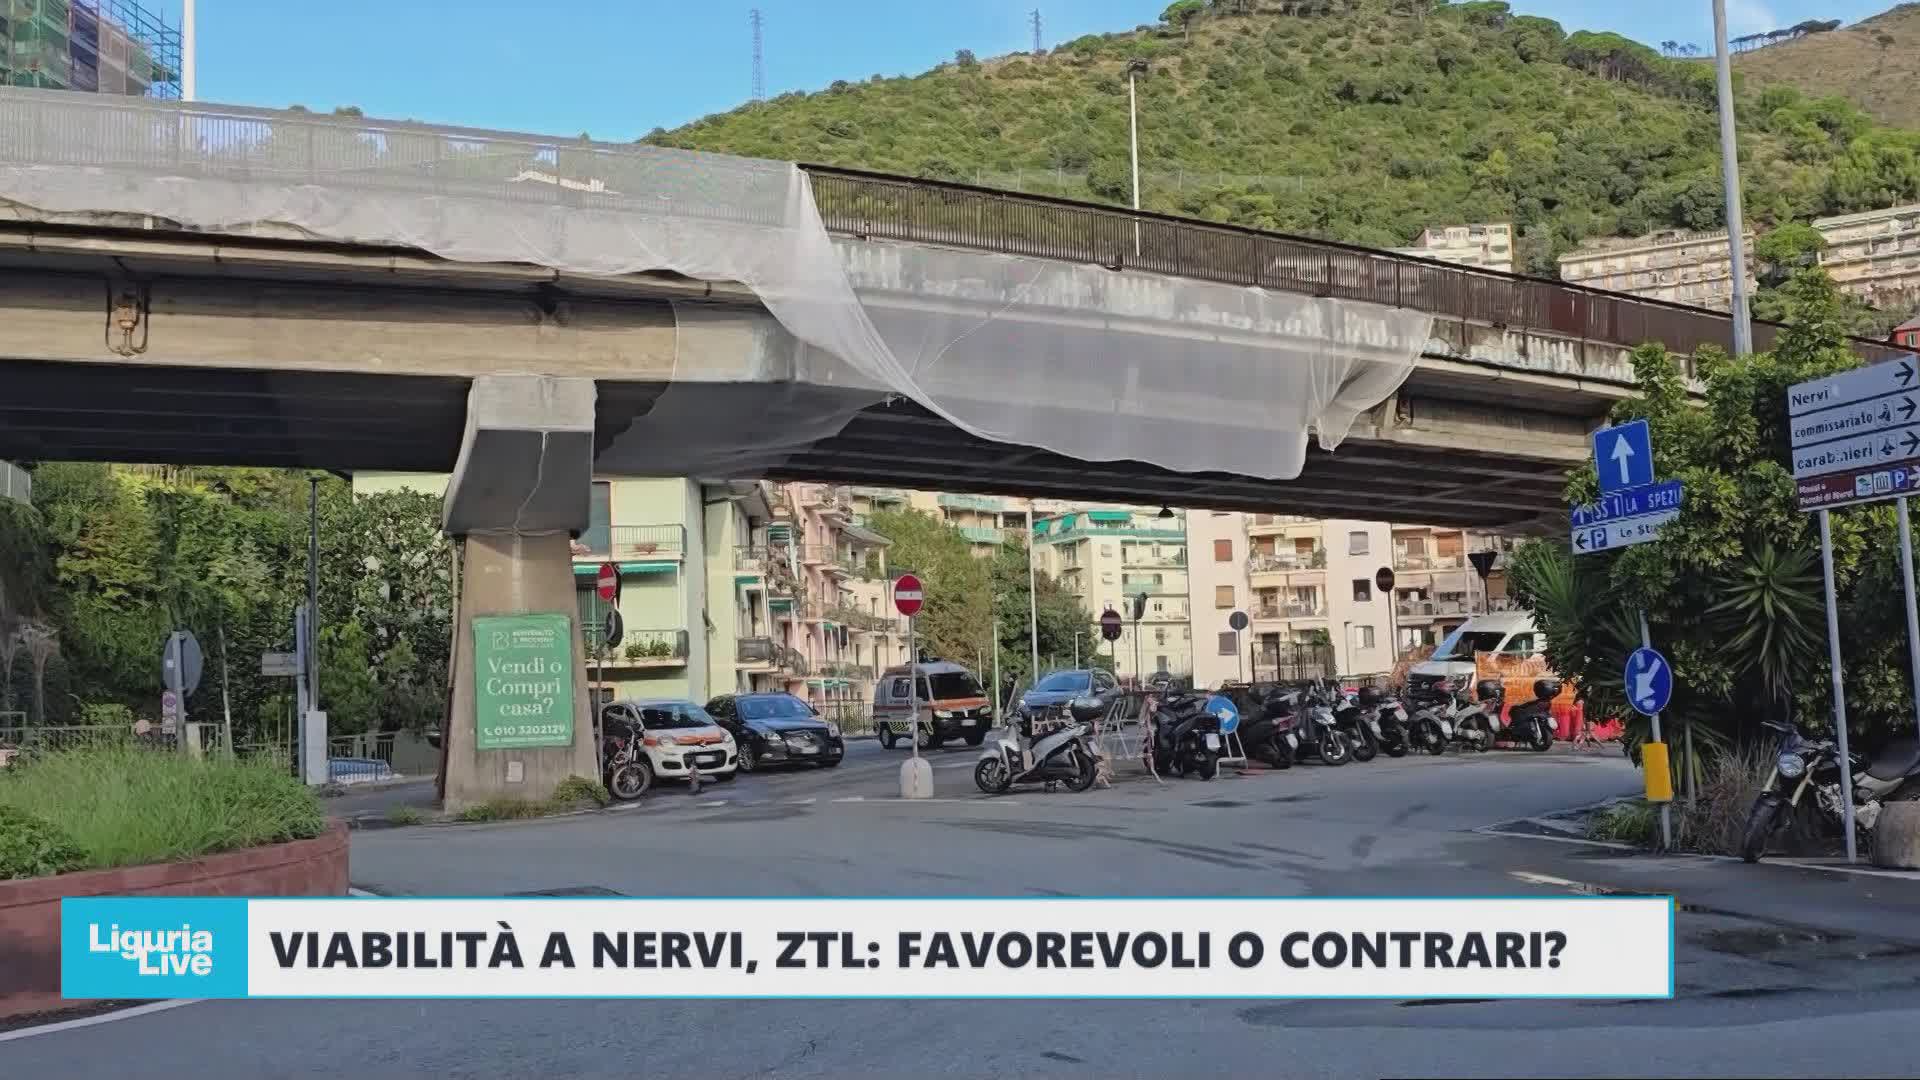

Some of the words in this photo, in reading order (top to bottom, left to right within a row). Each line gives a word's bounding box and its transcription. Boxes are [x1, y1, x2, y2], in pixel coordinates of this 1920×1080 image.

[1792, 386, 1829, 407] Nervi
[1795, 411, 1873, 438] commissariato
[1797, 442, 1873, 470] carabnieri
[1626, 495, 1638, 513] LA
[1594, 530, 1603, 548] P
[488, 657, 545, 674] Vendi
[550, 661, 563, 674] o
[486, 677, 560, 699] Compri
[499, 697, 554, 716] casa?
[494, 725, 516, 736] 010
